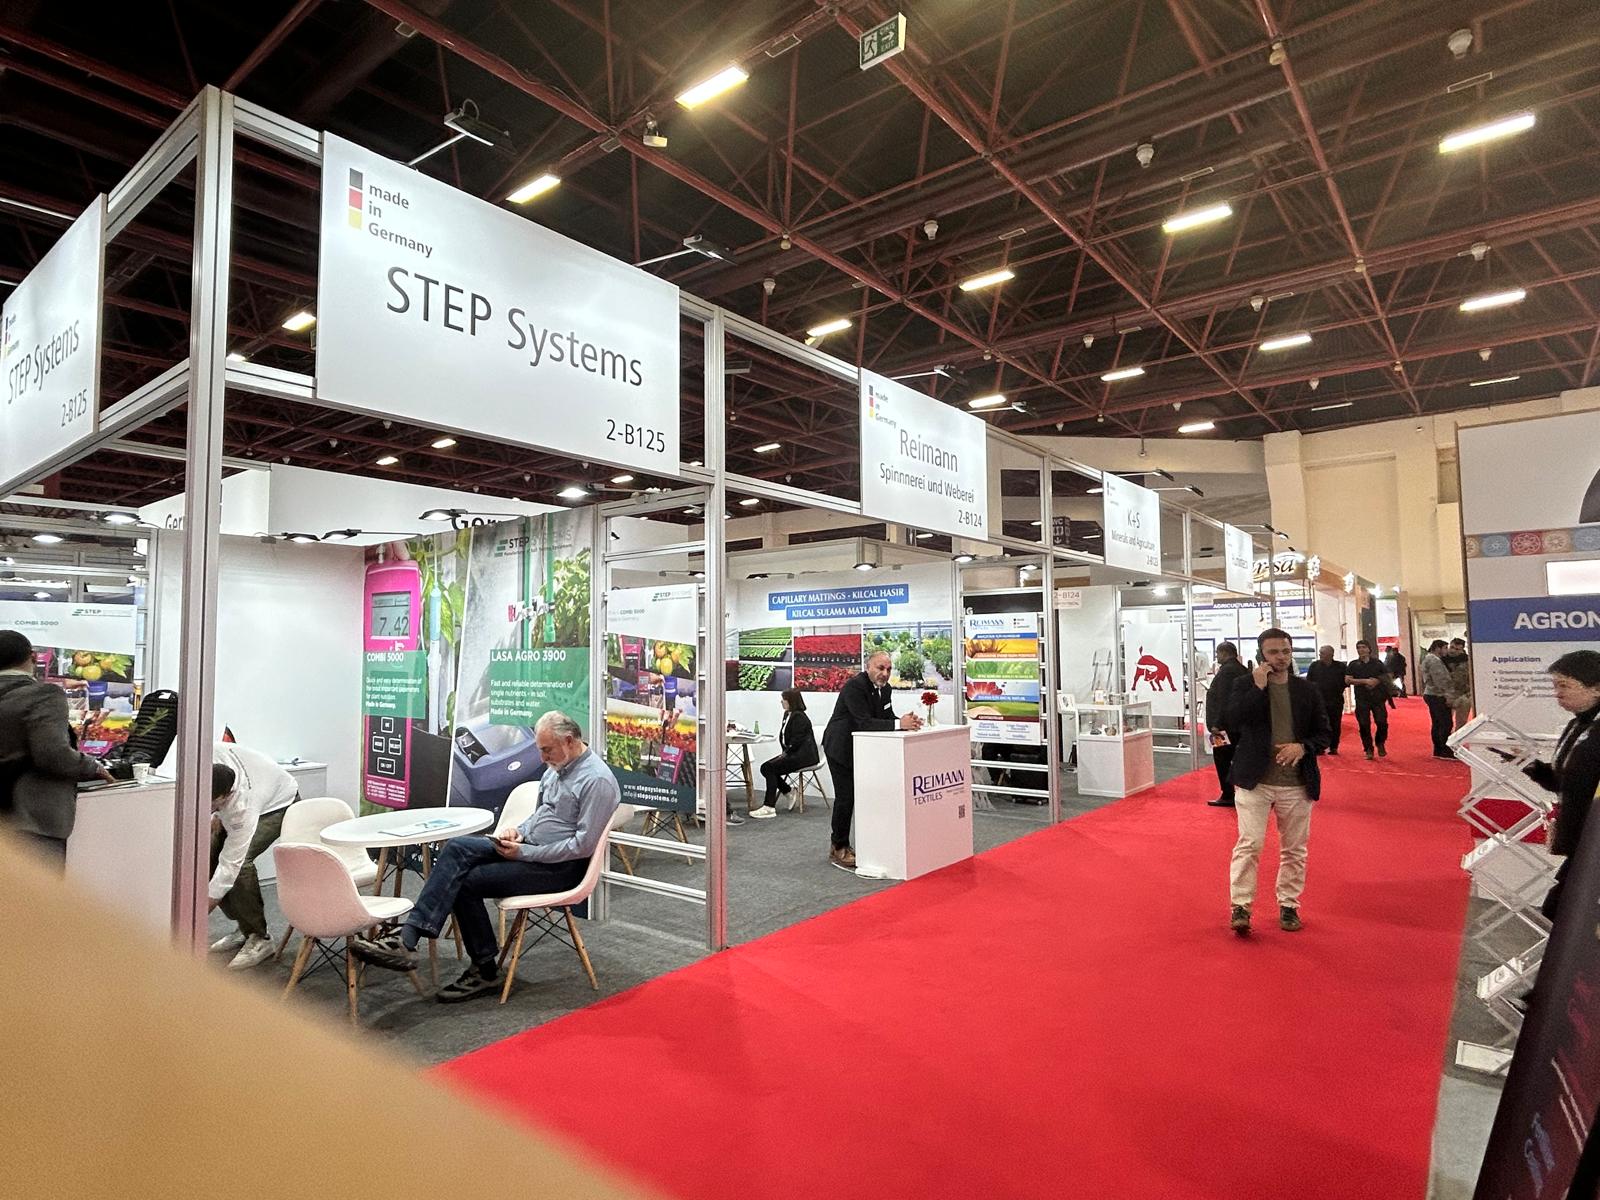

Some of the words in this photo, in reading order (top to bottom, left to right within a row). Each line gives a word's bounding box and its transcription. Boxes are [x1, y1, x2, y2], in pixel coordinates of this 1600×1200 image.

[881, 40, 895, 52] EXIT
[369, 182, 409, 209] made
[368, 201, 382, 218] in
[368, 223, 433, 258] Germany
[386, 266, 492, 336] STEP
[507, 307, 643, 387] Systems
[8, 353, 32, 405] STEP
[34, 319, 80, 391] Systems
[61, 388, 88, 427] 2-B125
[606, 419, 666, 454] 2-B125
[900, 429, 959, 473] Reimann
[928, 479, 943, 495] und
[944, 481, 975, 504] Weberei
[958, 509, 983, 528] 2-B124
[1127, 509, 1141, 529] K+S
[509, 537, 530, 549] STEP
[772, 594, 807, 605] CAPILLARY
[808, 592, 846, 602] MATTINGS
[852, 589, 878, 599] KILCAL
[880, 588, 904, 598] HASIR
[791, 608, 814, 618] KILCAL
[816, 607, 847, 617] SULAMA
[847, 605, 881, 615] MATLARI
[1514, 611, 1600, 630] AGRON
[380, 616, 409, 637] 7.42
[367, 652, 386, 662] COMBI
[387, 652, 404, 662] 5000
[491, 650, 513, 661] LASA
[515, 650, 540, 661] AGRO
[542, 650, 566, 661] 3900
[1492, 656, 1541, 664] Application
[512, 680, 529, 688] reliable
[510, 709, 533, 718] Germany.
[913, 769, 965, 796] REIMANN
[914, 792, 943, 805] TEXTILES
